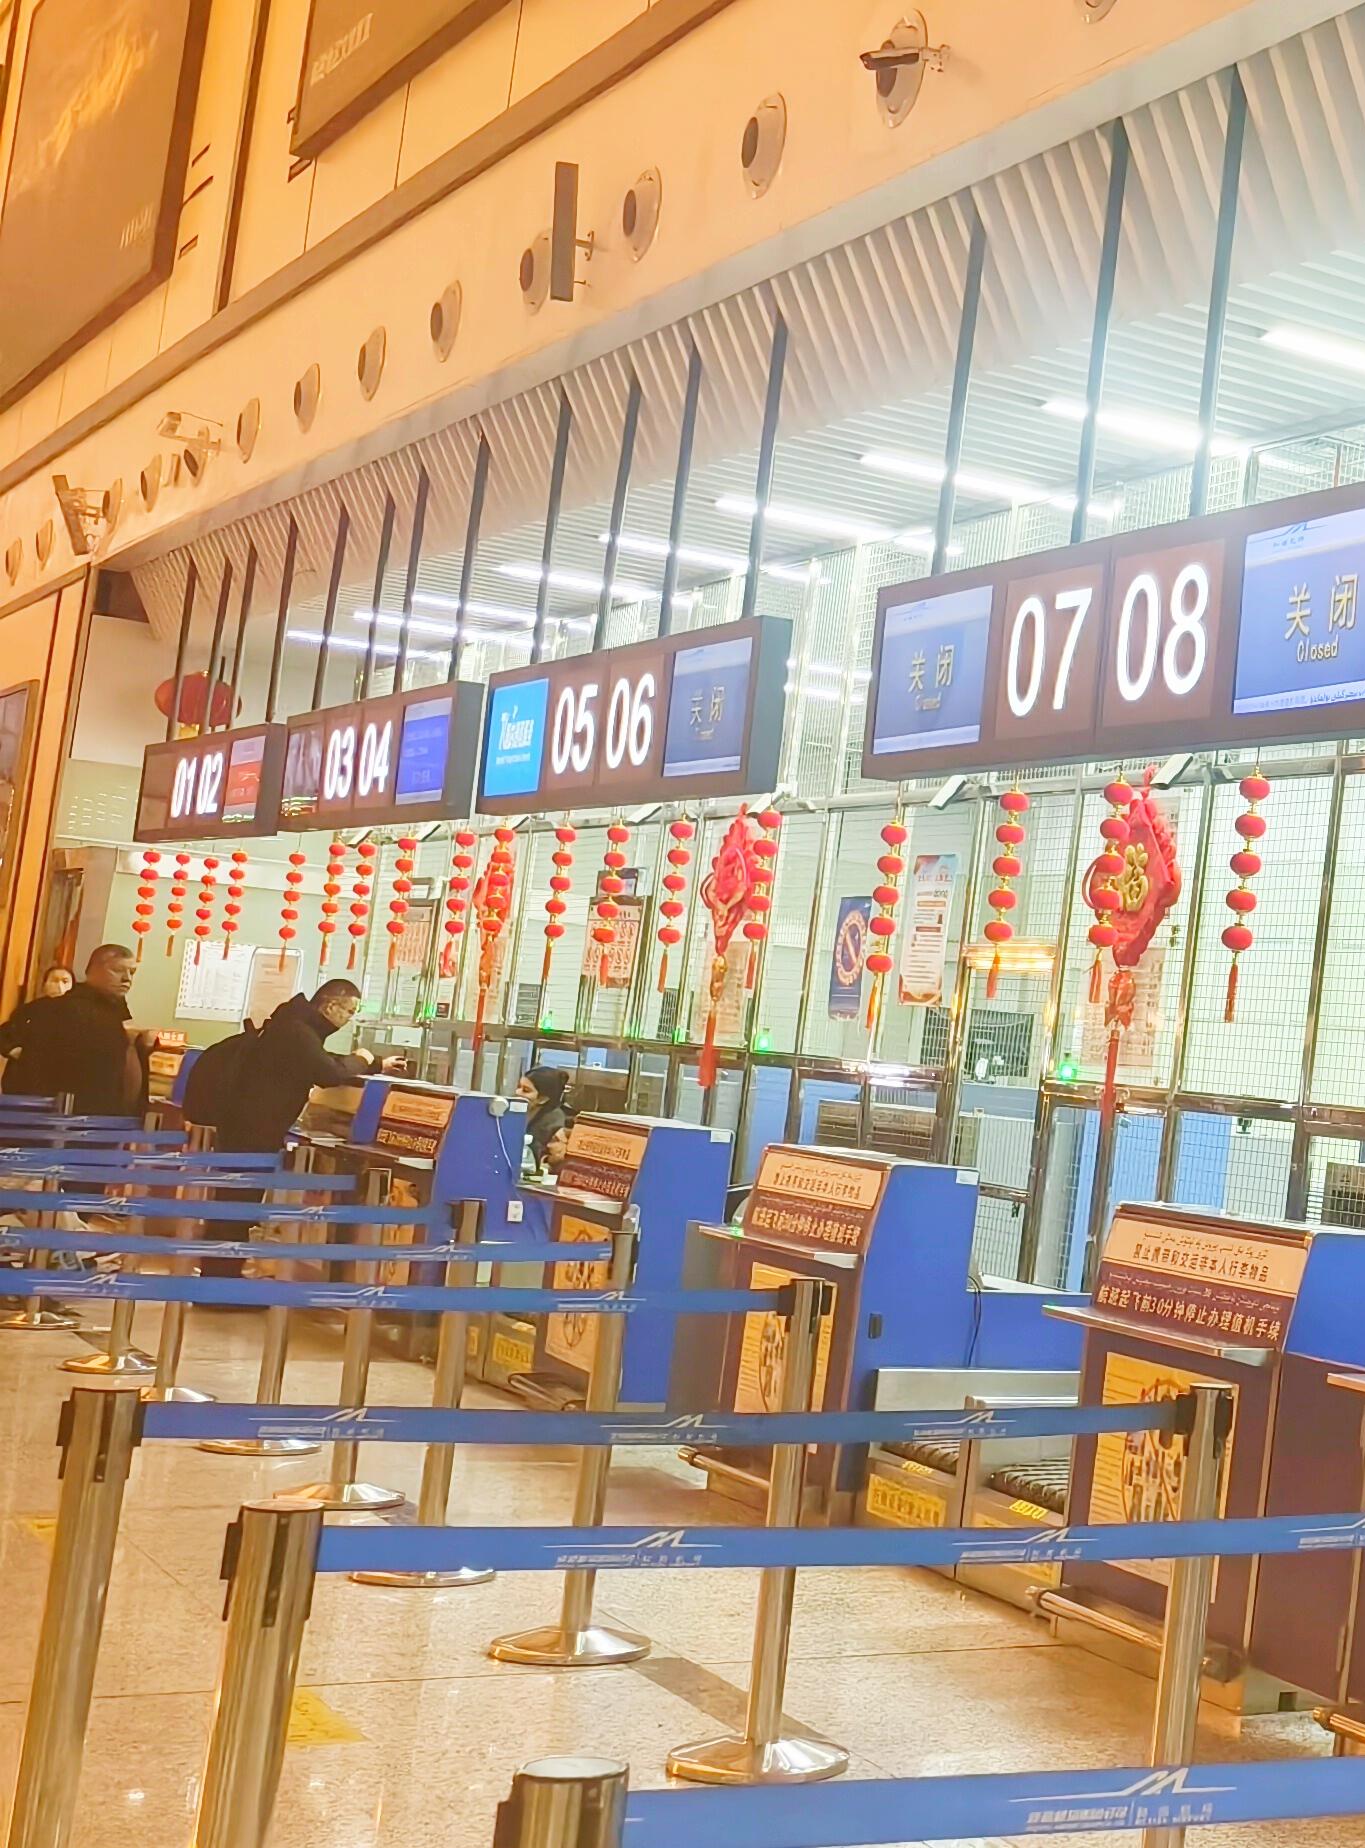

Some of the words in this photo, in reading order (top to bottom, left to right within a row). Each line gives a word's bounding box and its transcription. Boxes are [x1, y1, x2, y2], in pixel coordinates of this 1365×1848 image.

[1006, 586, 1095, 718] 07
[1115, 560, 1211, 702] 08
[1284, 573, 1359, 641] 关闭
[907, 643, 955, 693] 关闭
[323, 725, 357, 801] 03
[357, 719, 393, 798] 04
[550, 683, 599, 775] 05
[604, 672, 657, 770] 06
[169, 755, 199, 819] 01
[195, 750, 224, 816] 02
